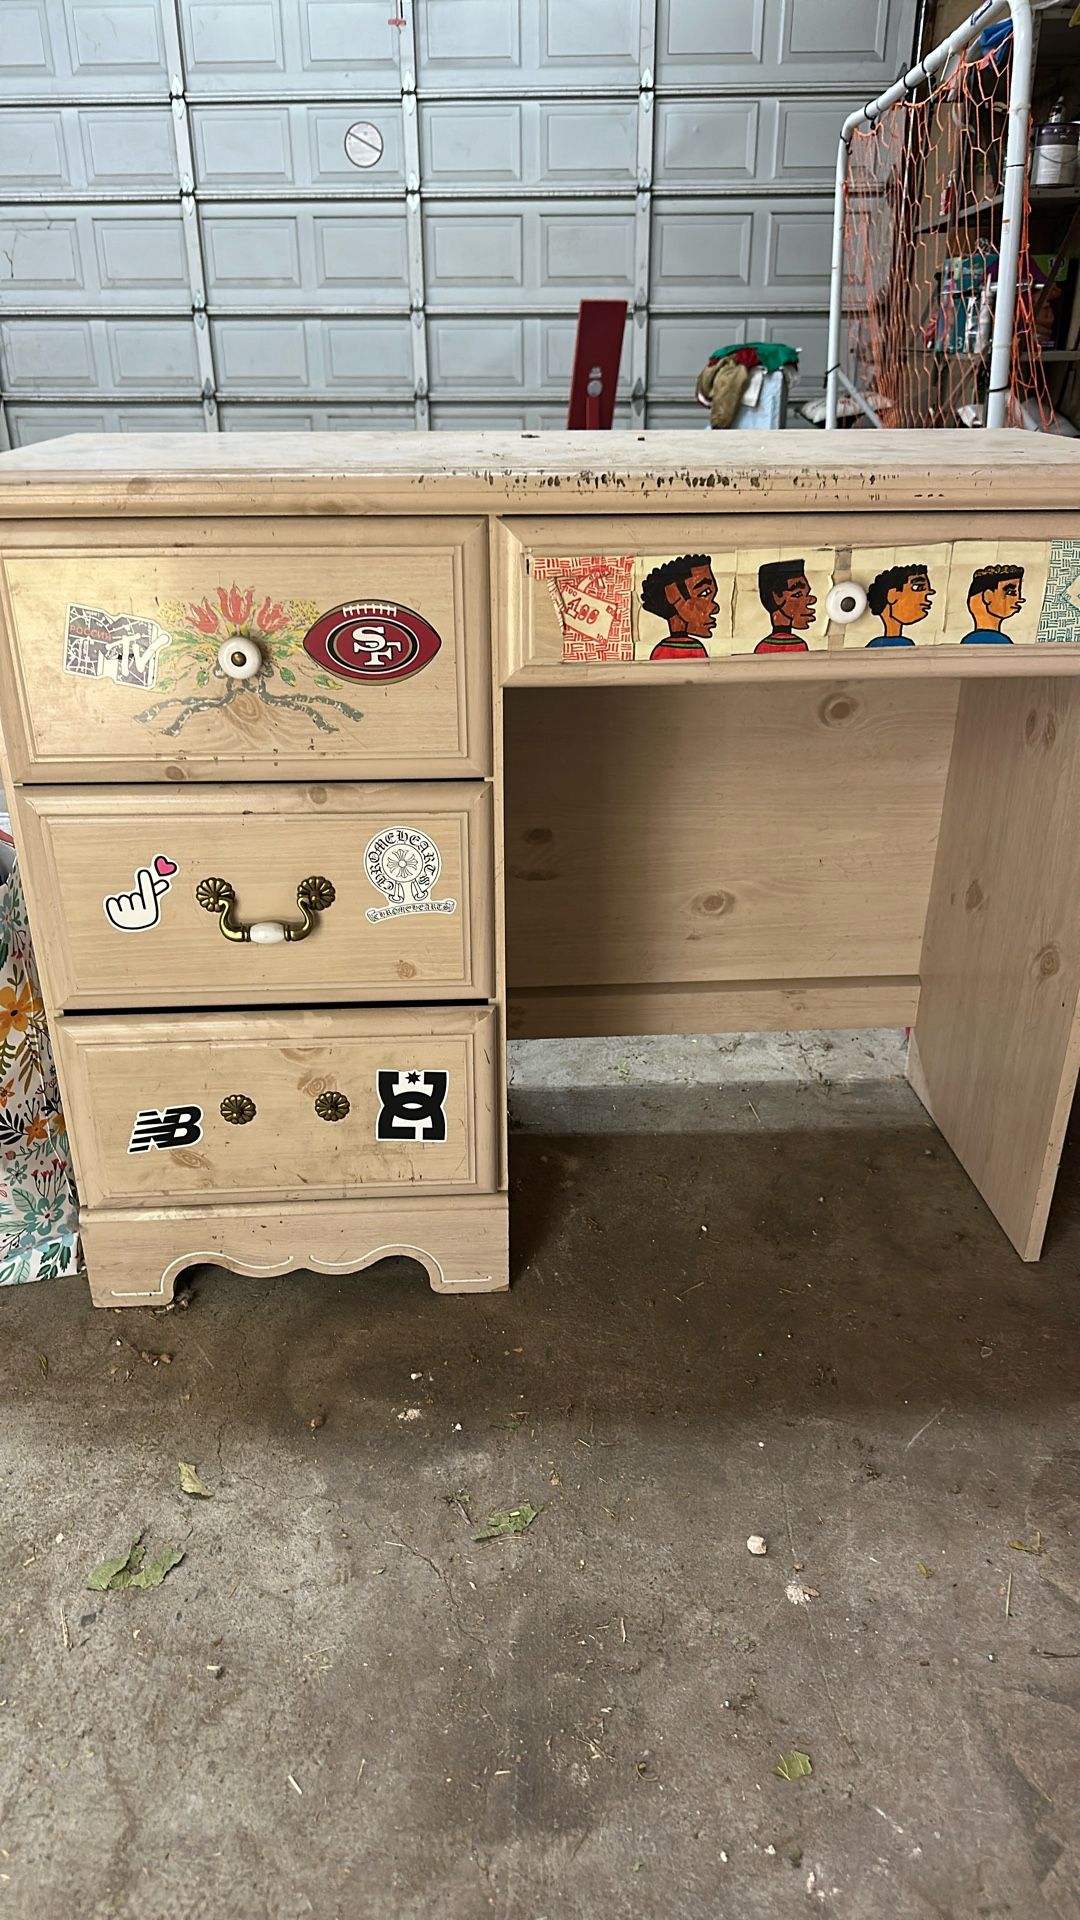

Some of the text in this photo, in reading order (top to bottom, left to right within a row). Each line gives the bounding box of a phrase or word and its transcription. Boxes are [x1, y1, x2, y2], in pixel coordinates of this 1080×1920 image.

[566, 598, 600, 625] 100
[352, 626, 402, 666] SF
[128, 1105, 202, 1153] NB
